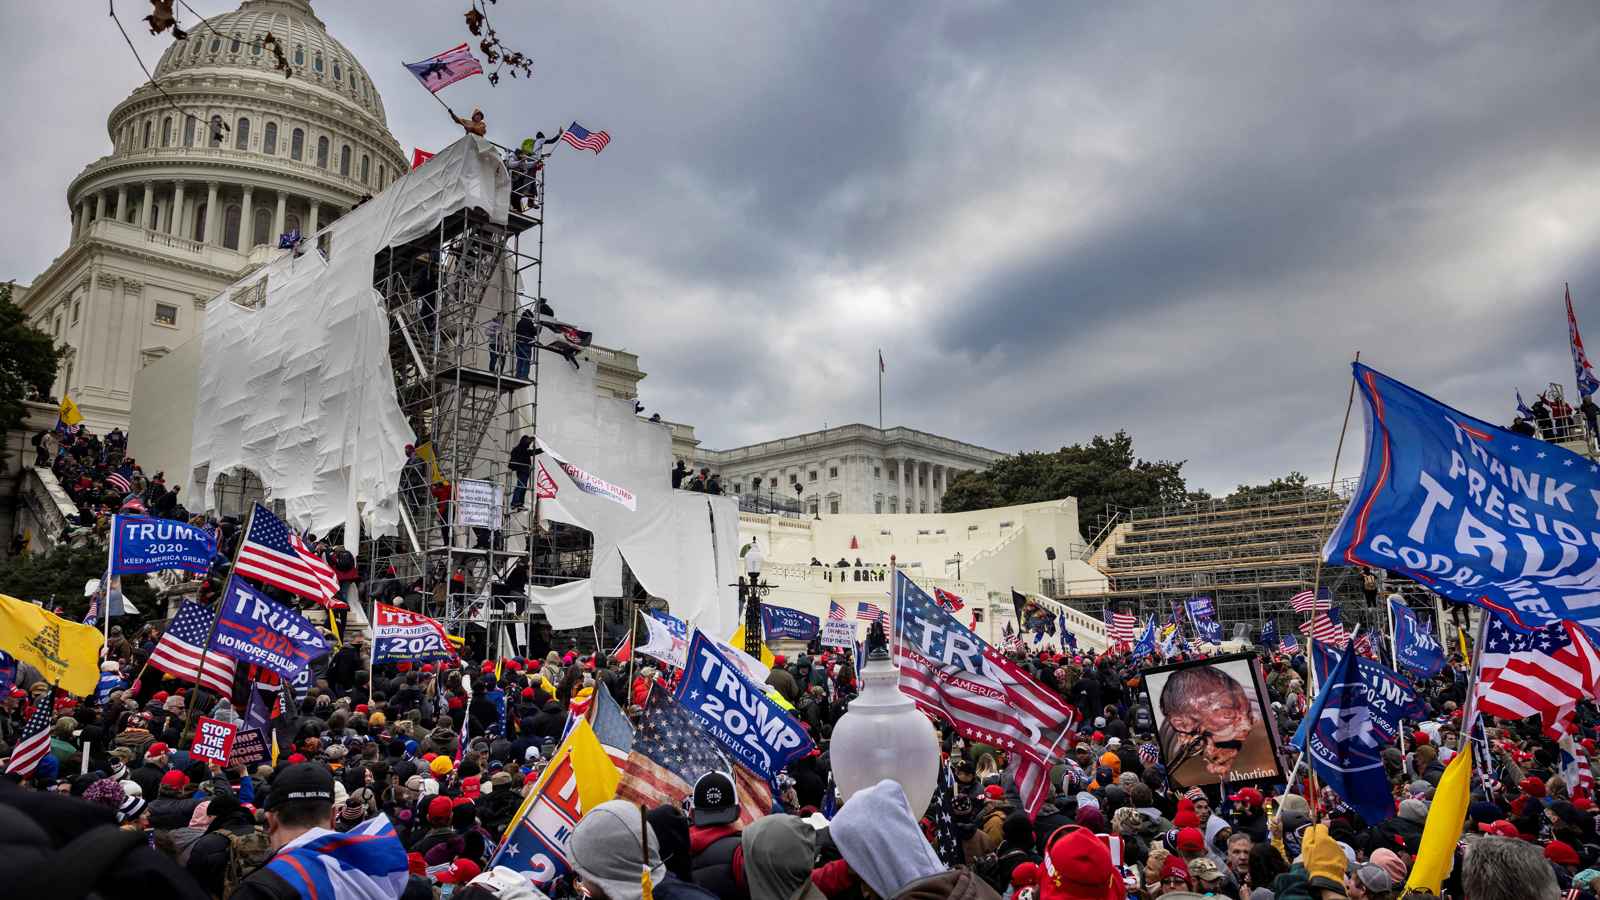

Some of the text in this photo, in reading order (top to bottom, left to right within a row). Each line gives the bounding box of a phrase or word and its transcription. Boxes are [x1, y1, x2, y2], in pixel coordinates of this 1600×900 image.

[1444, 416, 1576, 513] THANK
[124, 557, 144, 565] KEEP
[145, 555, 180, 564] AMERICA
[1370, 534, 1453, 574] GOD
[217, 633, 235, 647] NO
[234, 640, 268, 659] MORE
[700, 648, 800, 752] TRUMP
[951, 678, 1008, 705] AMERICA
[202, 722, 232, 737] STOP
[203, 734, 225, 748] THE
[193, 744, 226, 761] STEAL
[708, 725, 757, 766] AMERICA
[1230, 767, 1276, 782] Abortion
